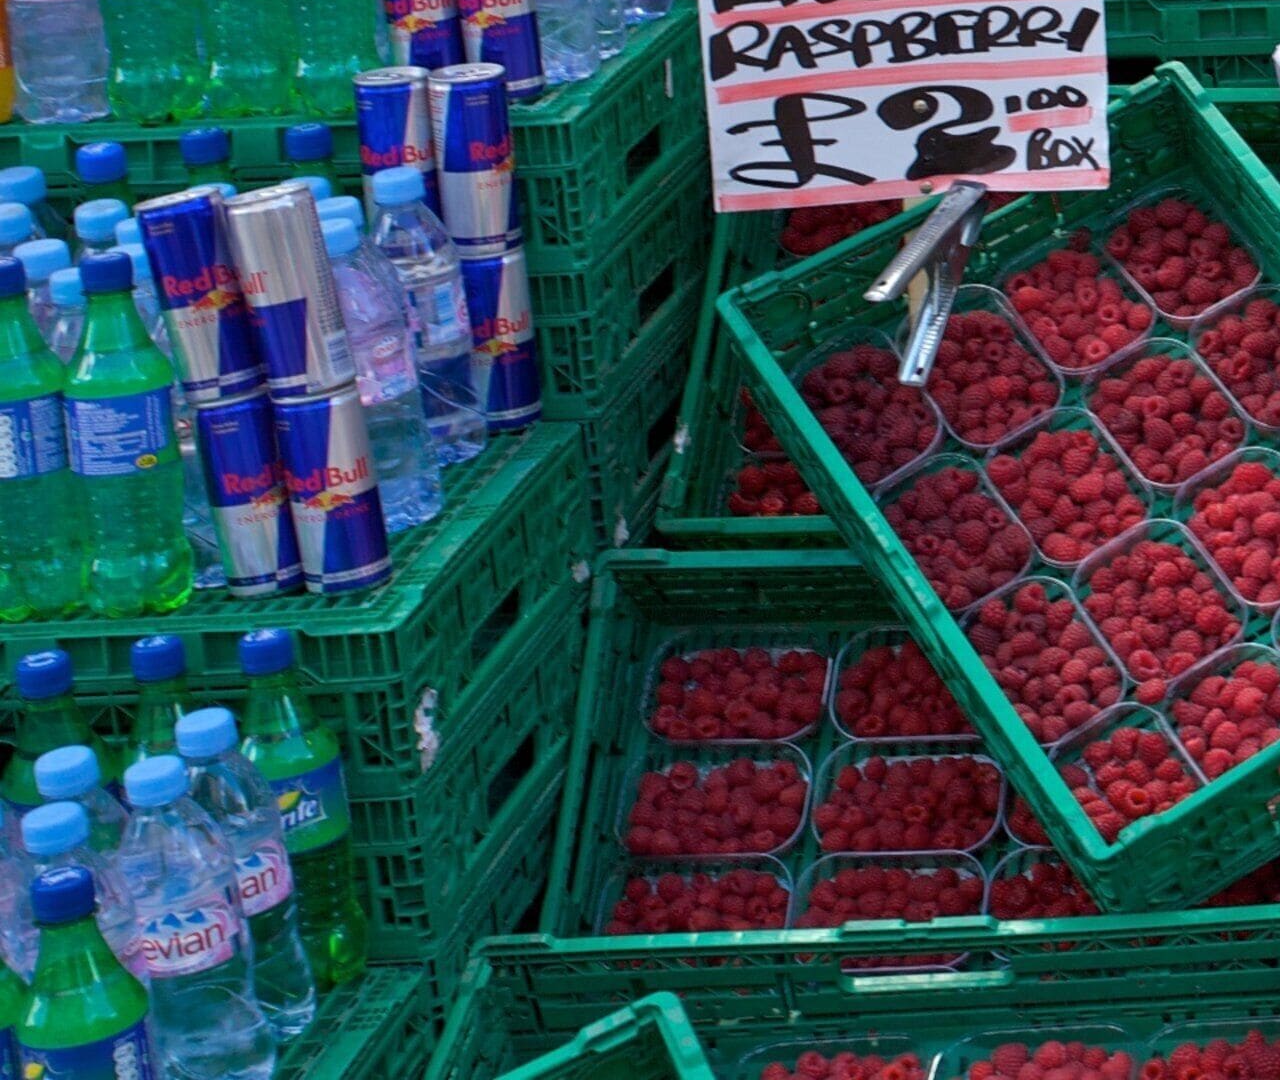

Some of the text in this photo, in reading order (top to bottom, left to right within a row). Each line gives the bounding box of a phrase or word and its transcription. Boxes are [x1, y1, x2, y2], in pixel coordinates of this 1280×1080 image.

[469, 137, 511, 162] Red
[726, 84, 1101, 190] £2.00 BOX
[360, 144, 398, 167] Red
[162, 267, 213, 298] Red
[494, 311, 529, 337] Bull
[223, 465, 273, 496] Red
[325, 456, 369, 489] Bull
[142, 921, 227, 962] evian
